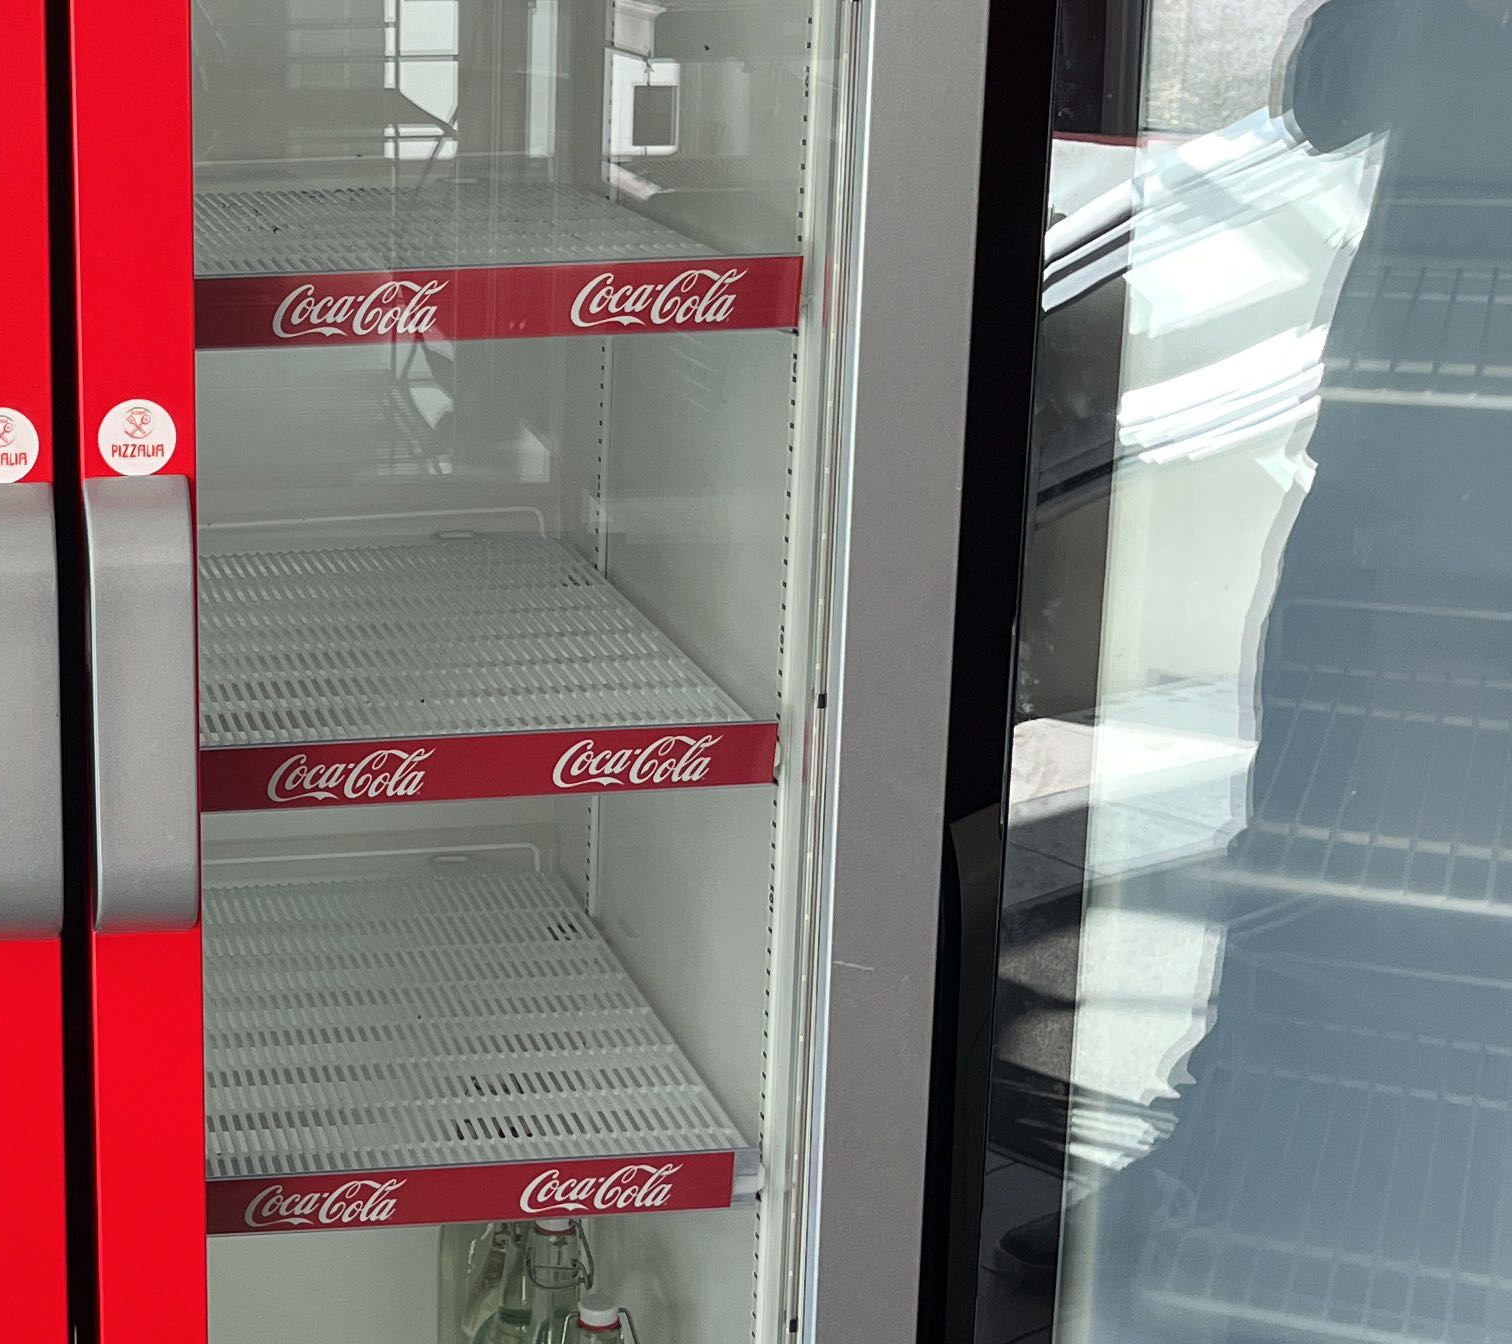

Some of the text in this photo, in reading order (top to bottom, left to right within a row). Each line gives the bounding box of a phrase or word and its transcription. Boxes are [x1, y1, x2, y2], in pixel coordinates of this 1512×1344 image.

[273, 280, 450, 341] Coca-Cola
[570, 267, 749, 329] Coca-Cola
[111, 443, 165, 458] PIZZALIA
[266, 746, 437, 803] Coca-Cola
[552, 733, 724, 789] Coca-Cola
[244, 1177, 407, 1230] Coca-Cola
[519, 1162, 684, 1214] Coca-Cola
